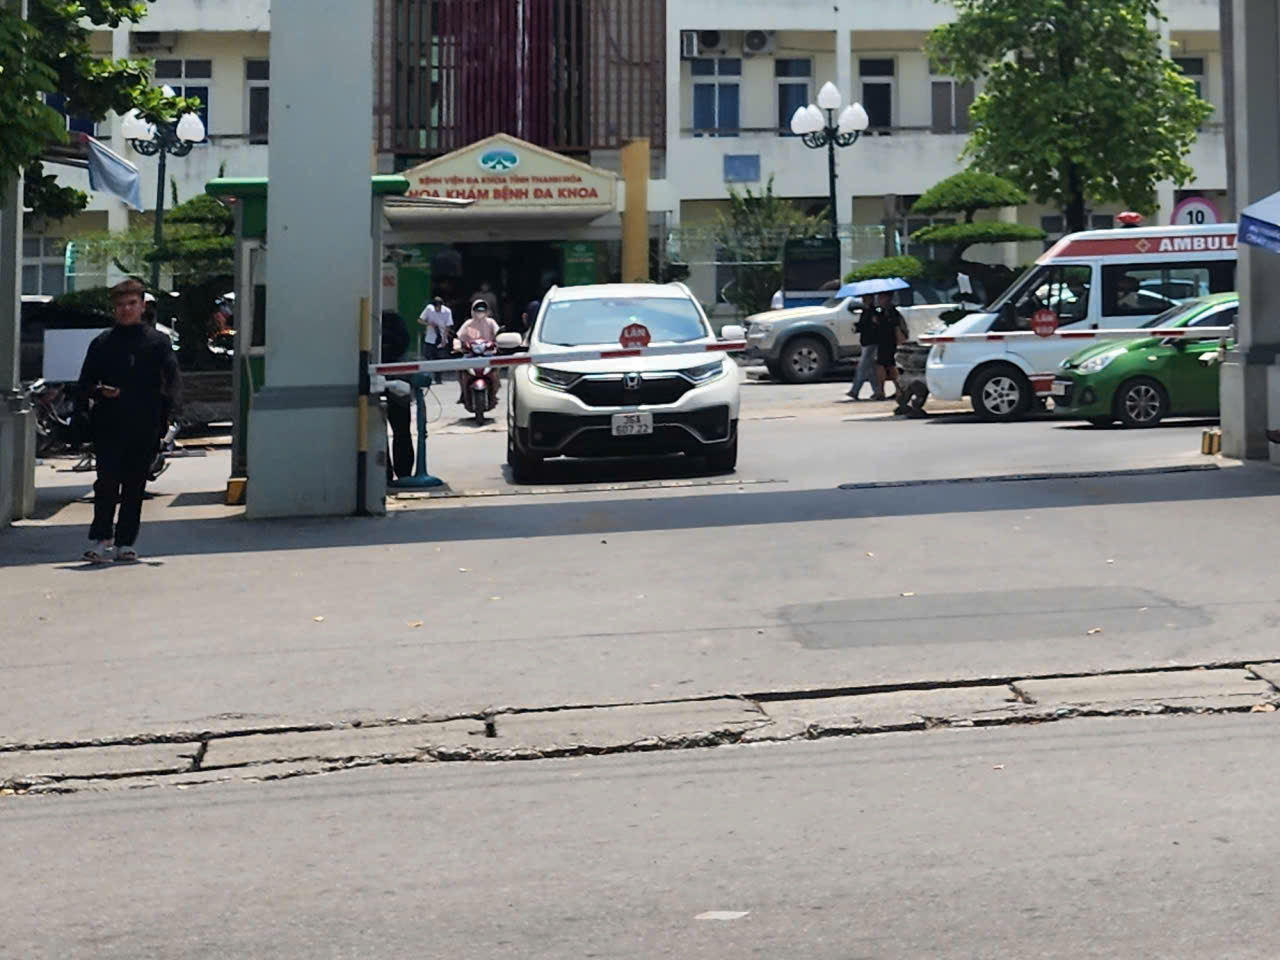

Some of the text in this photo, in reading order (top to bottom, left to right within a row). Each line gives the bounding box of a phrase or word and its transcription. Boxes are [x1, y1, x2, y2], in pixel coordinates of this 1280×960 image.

[494, 185, 528, 202] BỆNH
[558, 187, 598, 199] KHOA
[1186, 210, 1205, 224] 10
[1159, 236, 1239, 252] AMBUL
